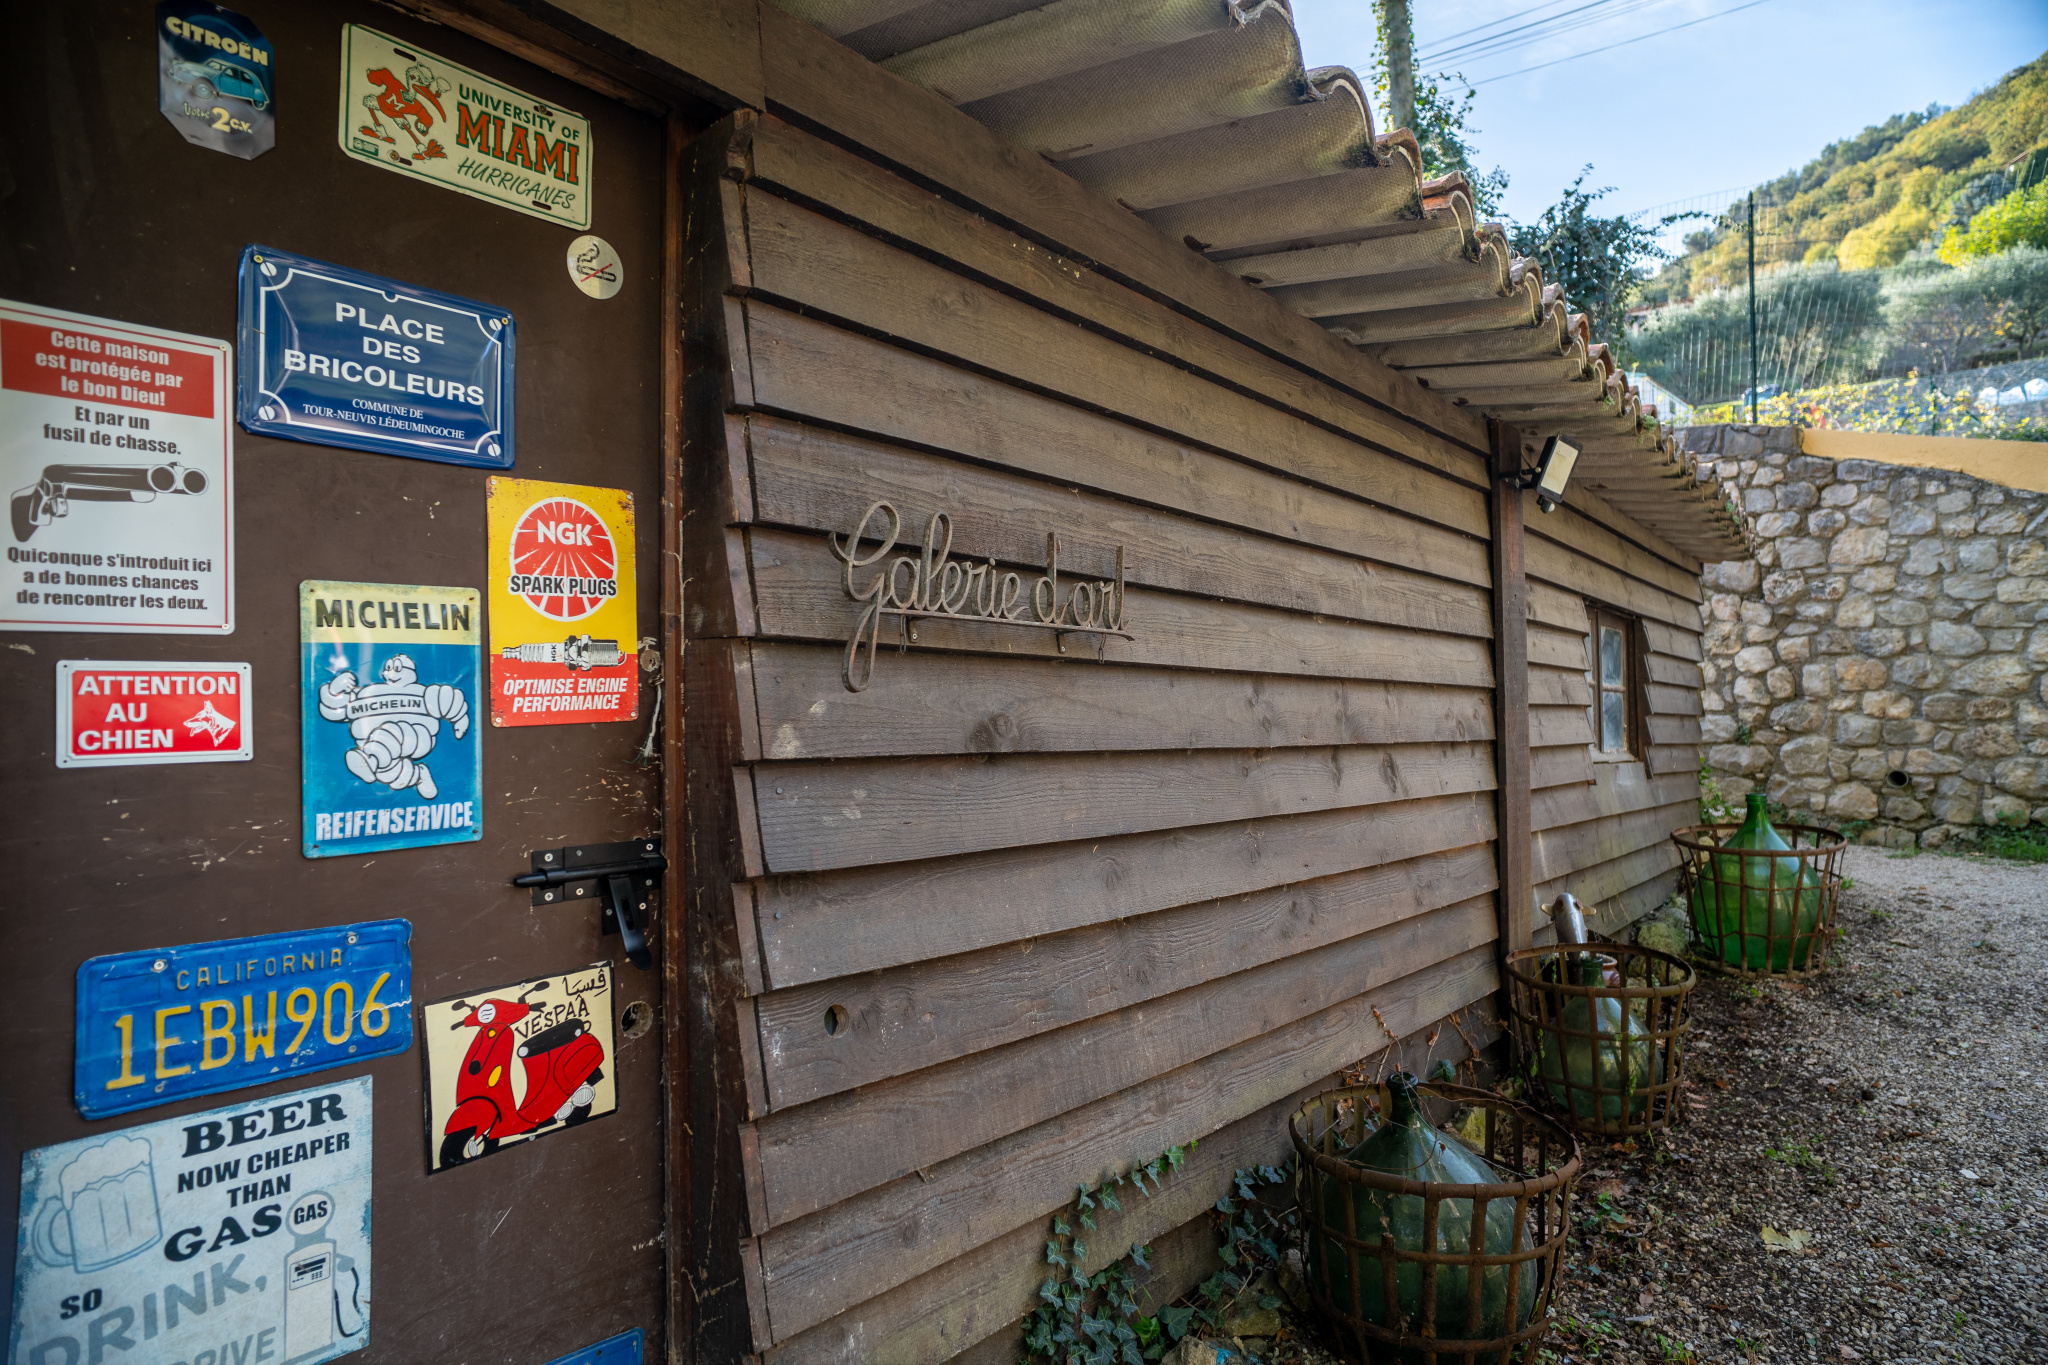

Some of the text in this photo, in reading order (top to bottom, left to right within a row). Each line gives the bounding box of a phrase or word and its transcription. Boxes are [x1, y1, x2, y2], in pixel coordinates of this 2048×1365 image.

[165, 16, 268, 66] CITROËN
[459, 83, 580, 141] UNIVERSITY OF
[456, 100, 579, 186] MIAMI
[457, 157, 576, 209] HURRICANES
[335, 302, 444, 345] PLACE
[51, 330, 169, 366] Cette maison
[363, 336, 421, 364] DES
[35, 352, 183, 389] est protégée par
[284, 348, 485, 406] BRICOLEURS
[61, 375, 166, 406] le bon Dieu!
[75, 405, 150, 430] Et par un
[302, 403, 465, 440] TOUR-NEUVIS LÉDEUMINGOCHE
[352, 398, 424, 419] COMMUNE DE
[43, 424, 181, 455] fusil de chasse.
[537, 519, 593, 547] NGK
[7, 546, 212, 573] Quiconque s'introduit ici
[23, 570, 199, 591] a de bonnes chances
[510, 575, 617, 597] SPARK PLUGS
[828, 500, 1030, 693] Galerie
[16, 589, 208, 610] de rencontrer les deux.
[316, 599, 470, 631] MICHELIN
[77, 675, 236, 696] ATTENTION
[503, 677, 628, 695] OPTIMISE ENGINE
[105, 703, 147, 722] AU
[351, 699, 422, 715] MICHELIN
[512, 694, 620, 712] PERFORMANCE
[77, 729, 173, 751] CHIEN
[315, 801, 473, 841] REIFENSERVICE
[177, 948, 343, 991] CALIFORNIA
[105, 971, 392, 1091] 1EBW906
[181, 1093, 348, 1158] BEER
[177, 1132, 350, 1193] NOW CHEAPER
[227, 1174, 291, 1208] THAN
[293, 1200, 328, 1225] GAS
[164, 1204, 283, 1262] GAS
[29, 1253, 268, 1365] DRINK,
[60, 1288, 103, 1320] SO
